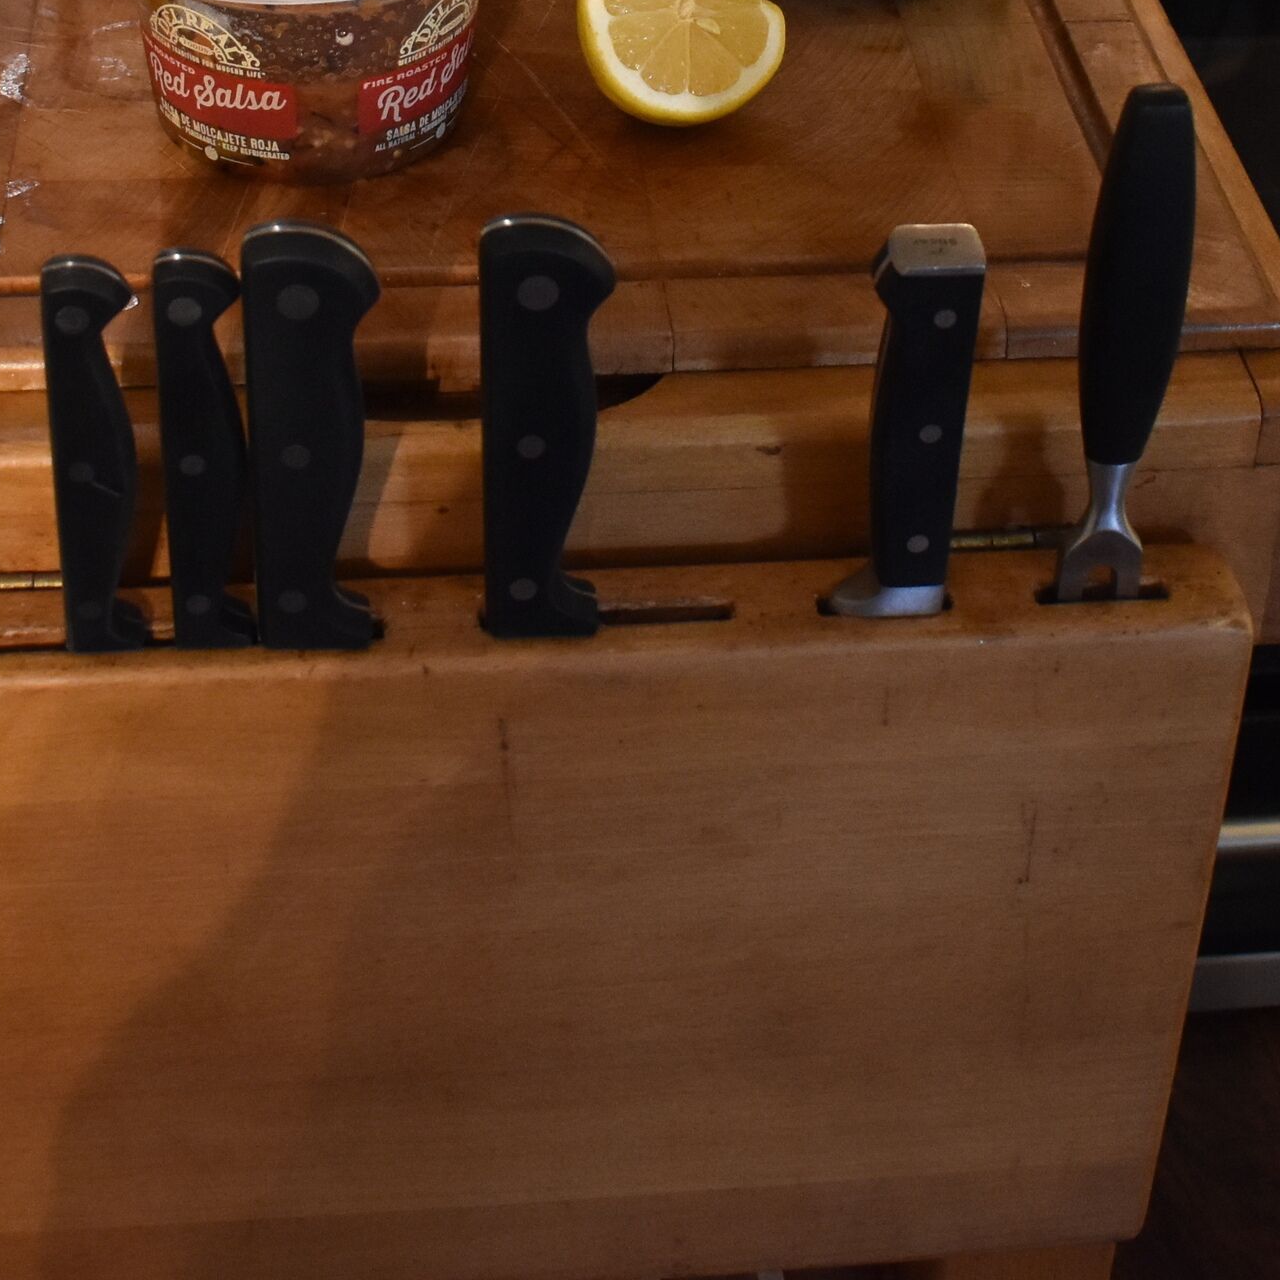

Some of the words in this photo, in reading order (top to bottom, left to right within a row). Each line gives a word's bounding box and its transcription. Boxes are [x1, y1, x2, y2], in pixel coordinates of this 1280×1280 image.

[150, 51, 190, 98] Red
[193, 75, 287, 111] Salsa
[377, 67, 437, 122] Red
[439, 30, 472, 93] Sal
[396, 53, 448, 80] ROASTED
[180, 112, 191, 128] DE
[193, 120, 248, 148] MOLCAJETE
[250, 138, 280, 152] ROJA
[386, 120, 416, 141] SALSA
